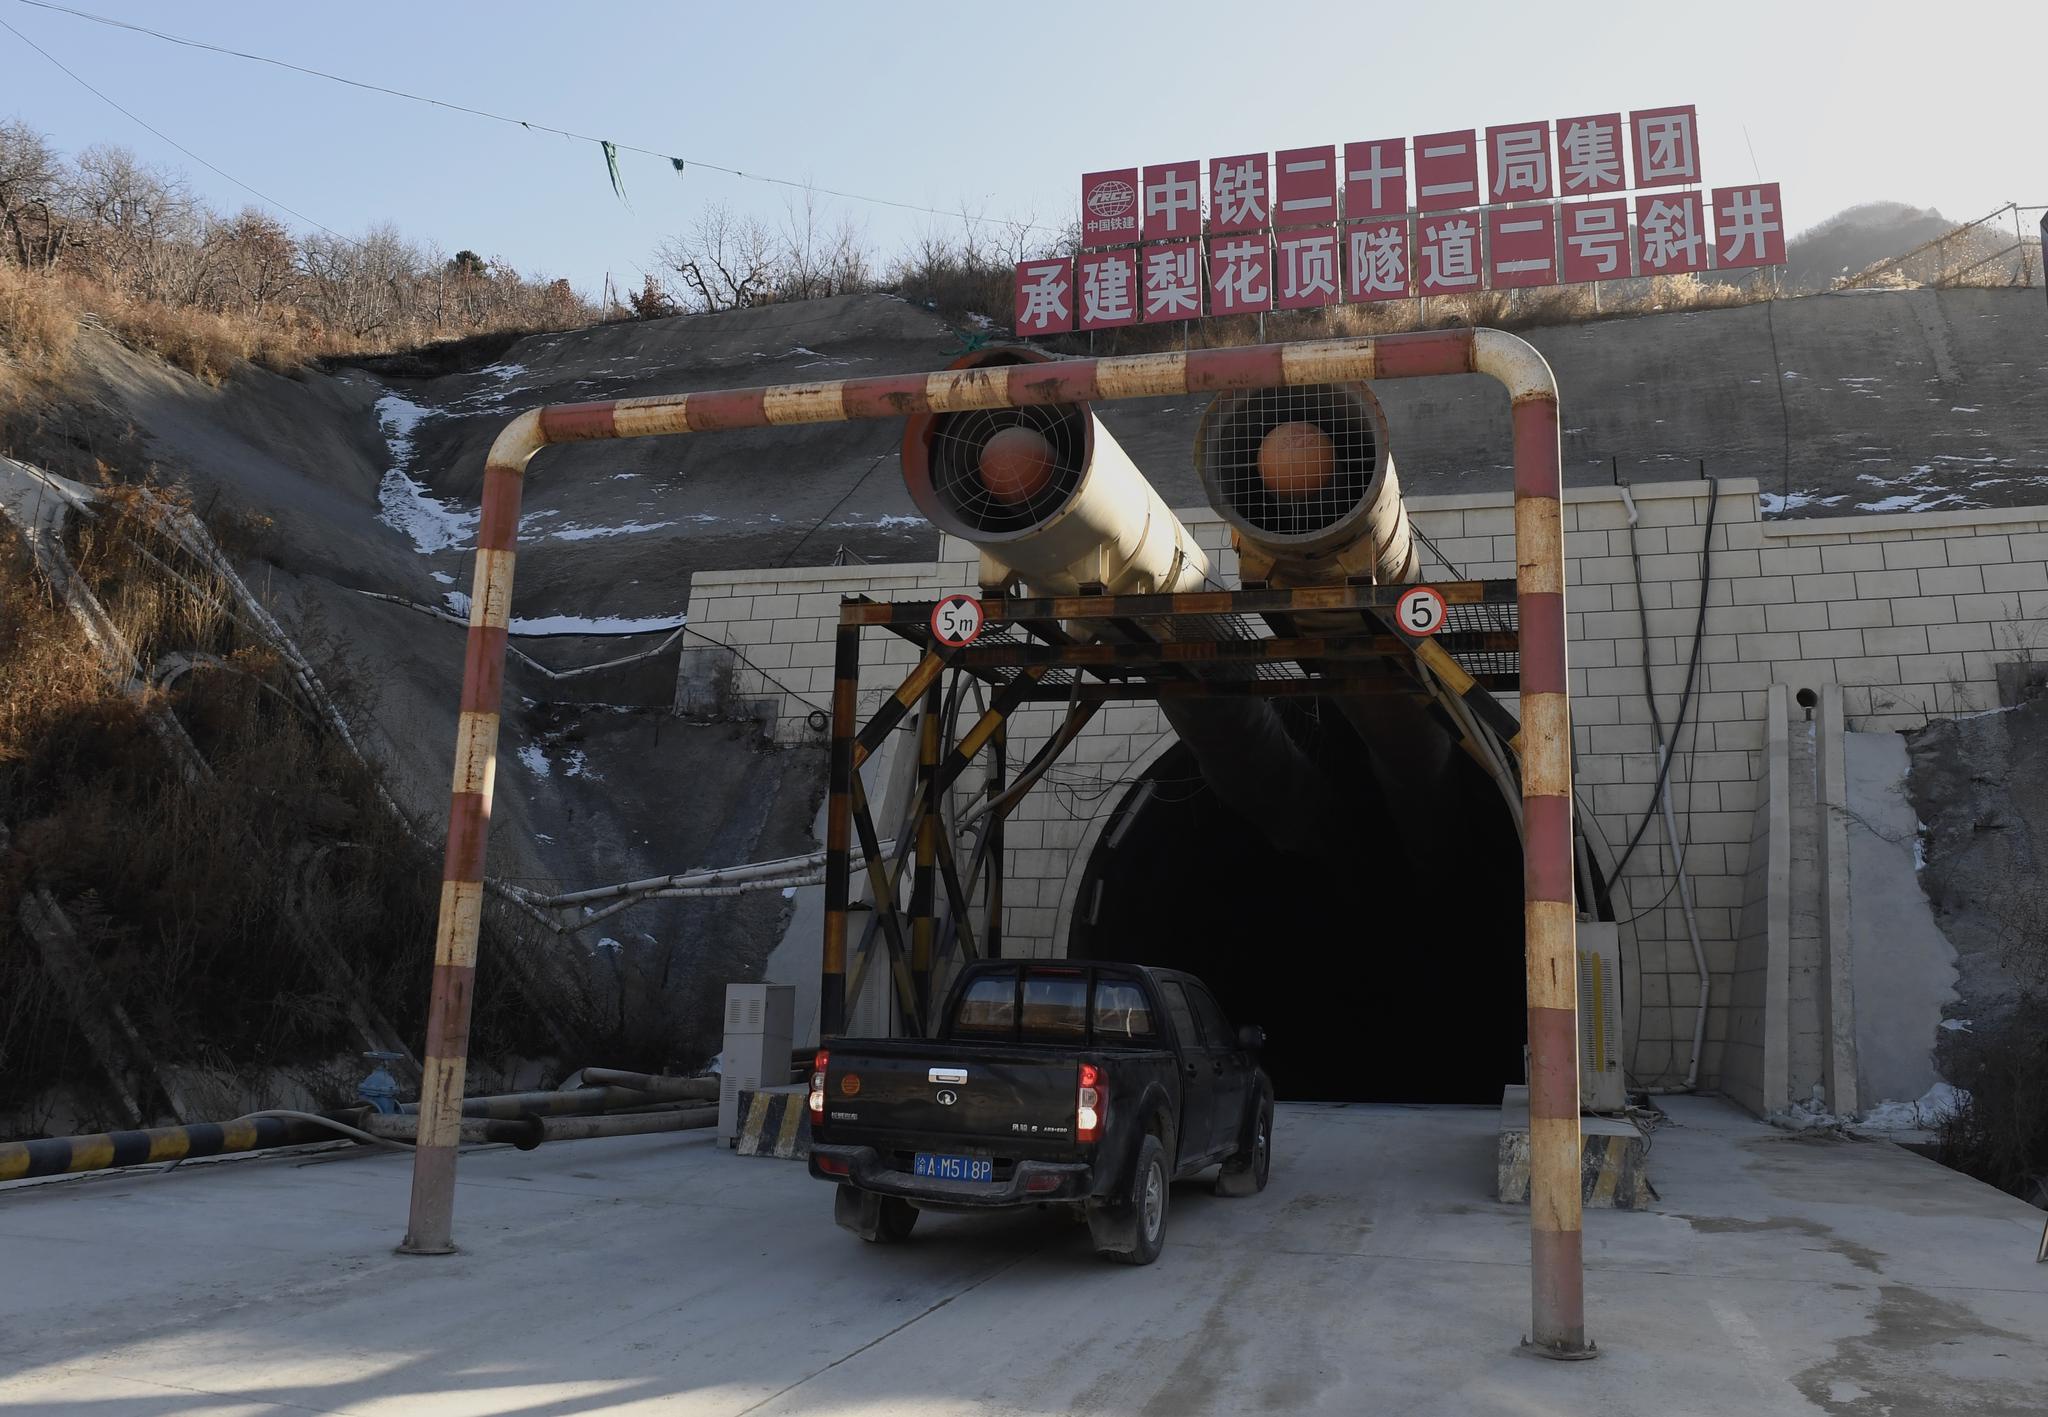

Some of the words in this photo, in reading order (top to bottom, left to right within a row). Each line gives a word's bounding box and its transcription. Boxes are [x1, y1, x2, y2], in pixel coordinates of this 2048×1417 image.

[1146, 113, 1696, 232] 中铁二十二局集团
[1019, 189, 1780, 329] 承建梨花顶隧道二号斜井
[1087, 215, 1136, 233] 中国铁建
[1411, 597, 1432, 628] 5
